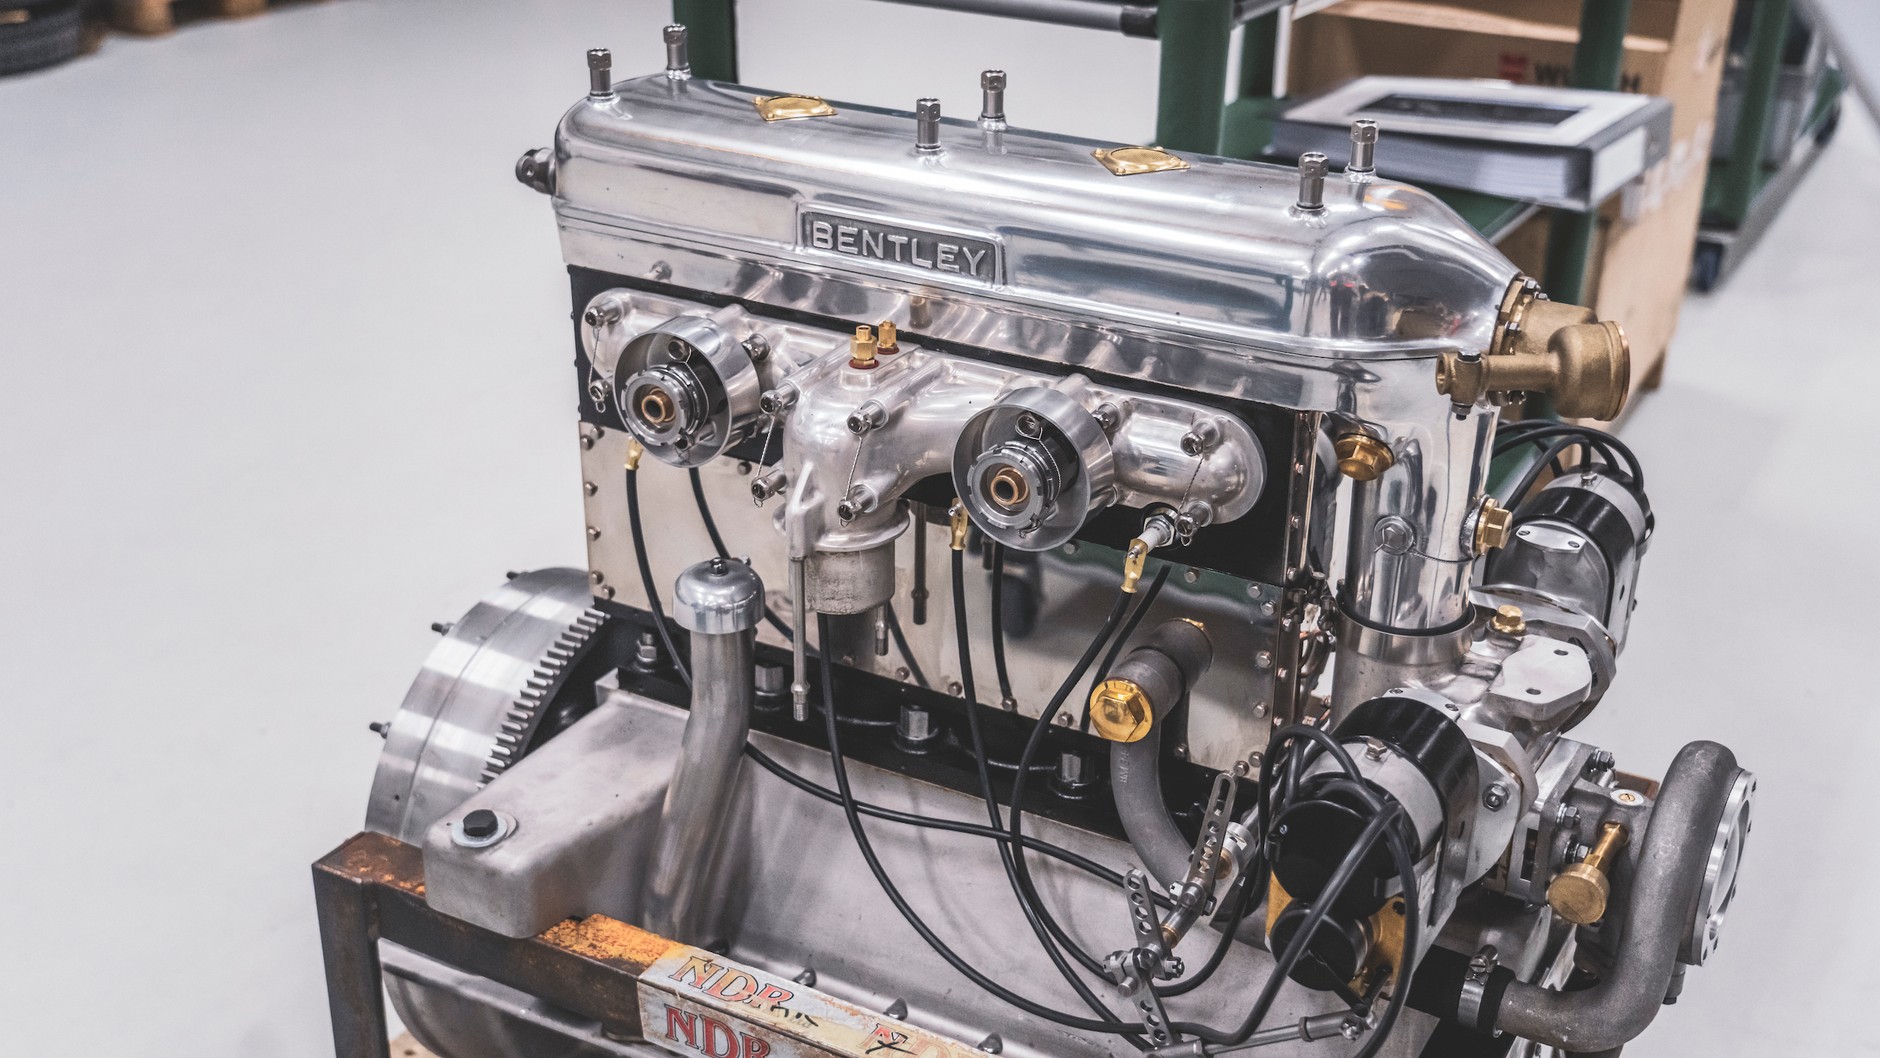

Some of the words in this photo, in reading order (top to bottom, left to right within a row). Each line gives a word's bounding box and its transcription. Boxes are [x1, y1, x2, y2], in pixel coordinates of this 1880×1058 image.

[812, 220, 986, 276] BENTLEY
[668, 955, 795, 1012] NDR
[664, 1003, 770, 1058] NDR
